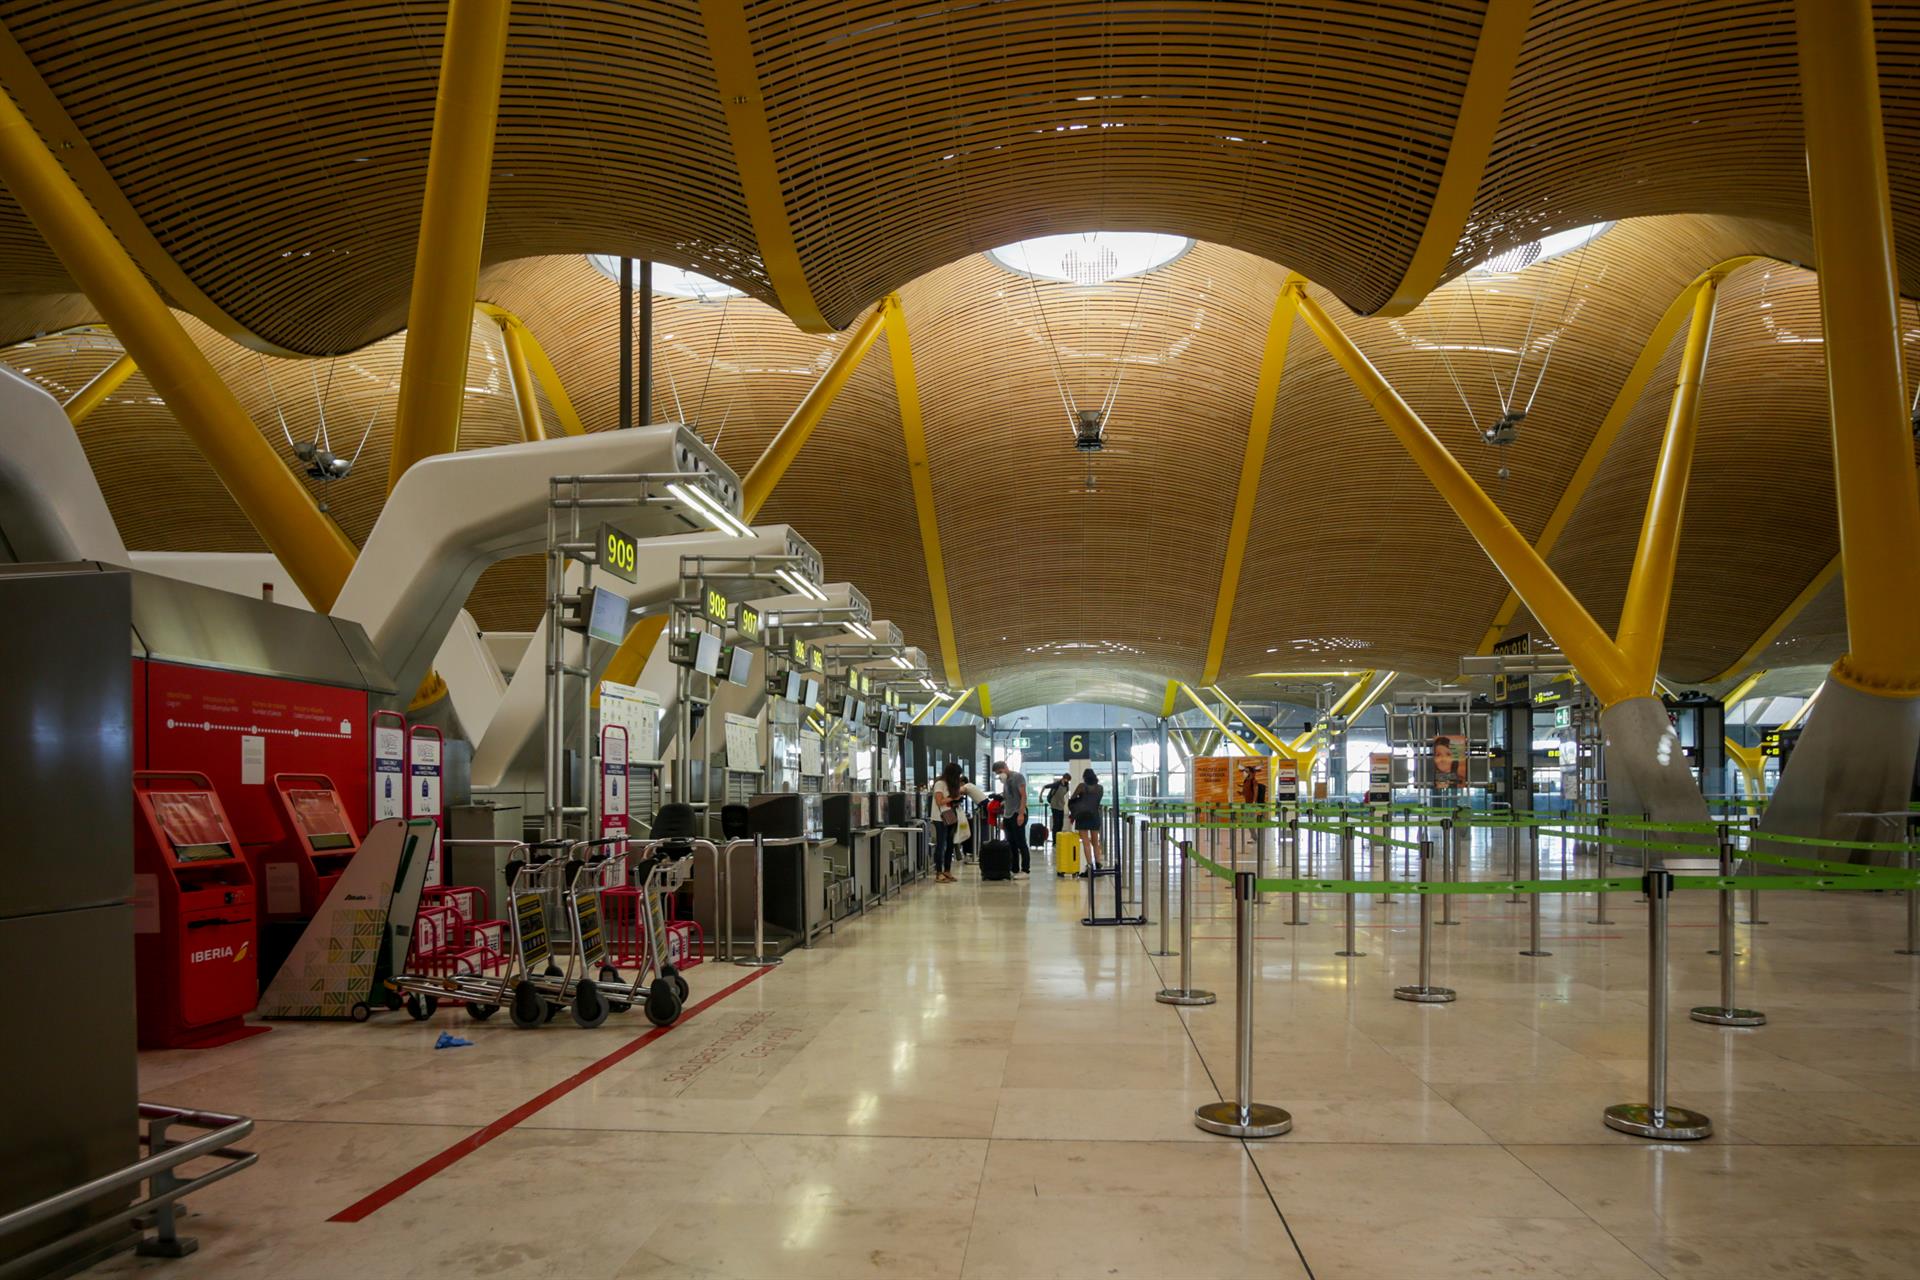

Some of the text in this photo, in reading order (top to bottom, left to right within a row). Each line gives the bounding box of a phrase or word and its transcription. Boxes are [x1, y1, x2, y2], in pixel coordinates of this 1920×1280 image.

[608, 534, 634, 572] 909
[709, 591, 726, 620] 908
[743, 609, 757, 633] 907
[1070, 735, 1083, 753] 6
[191, 946, 233, 963] IBERIA
